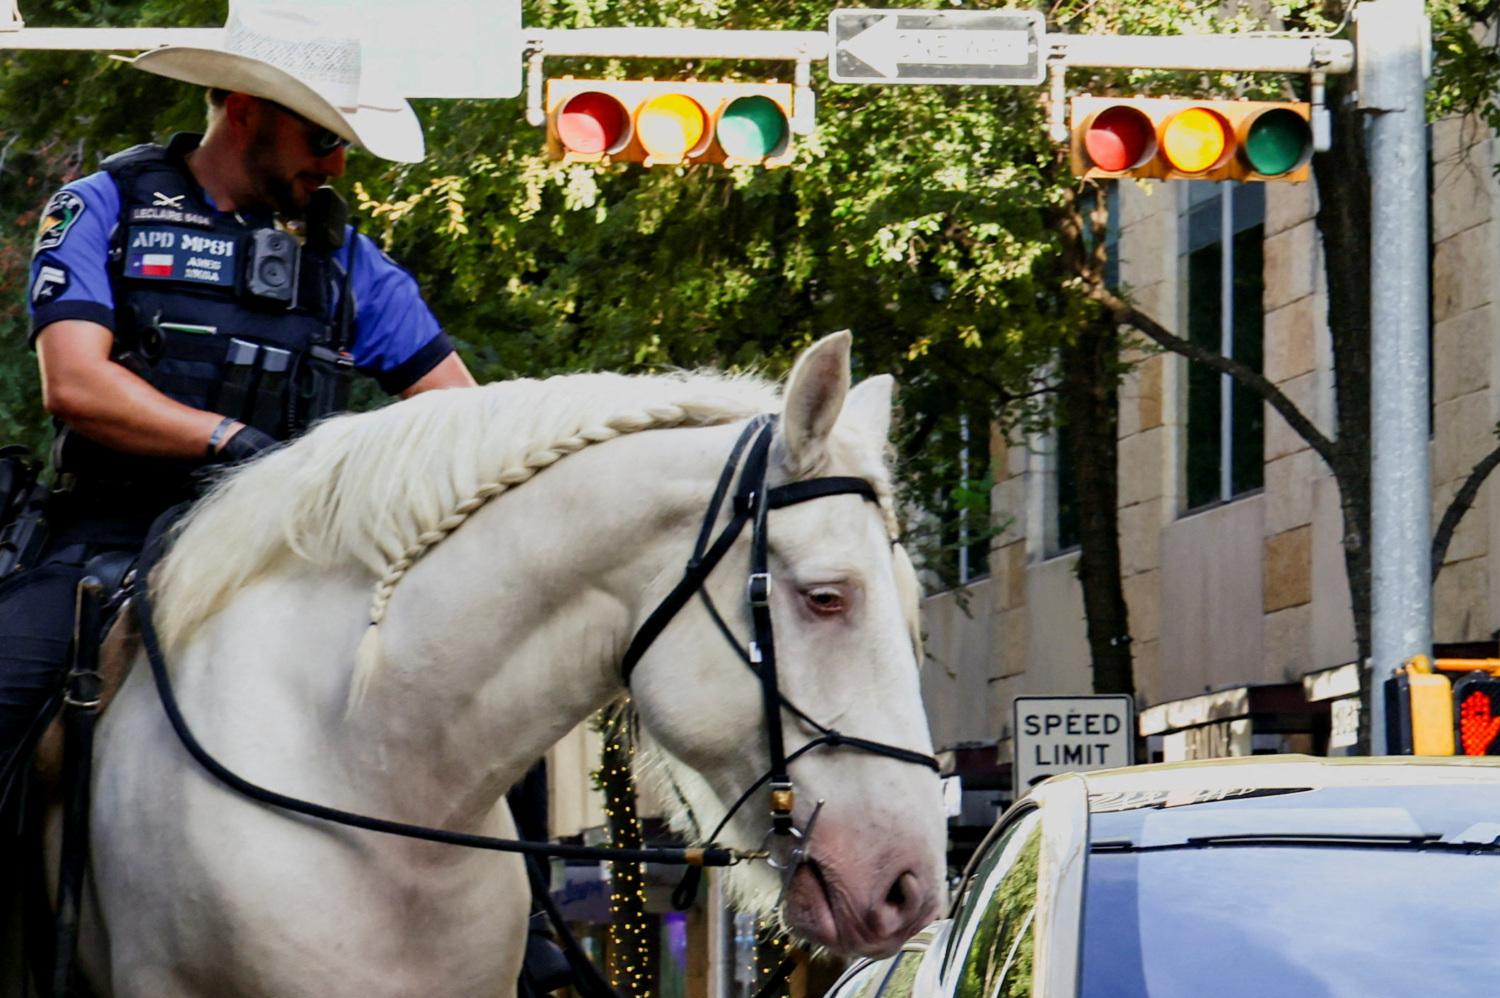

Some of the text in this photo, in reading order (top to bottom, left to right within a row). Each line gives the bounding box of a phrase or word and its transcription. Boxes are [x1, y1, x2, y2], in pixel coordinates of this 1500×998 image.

[132, 231, 175, 248] APD
[1025, 714, 1121, 735] SPEED
[1036, 744, 1110, 765] LIMIT
